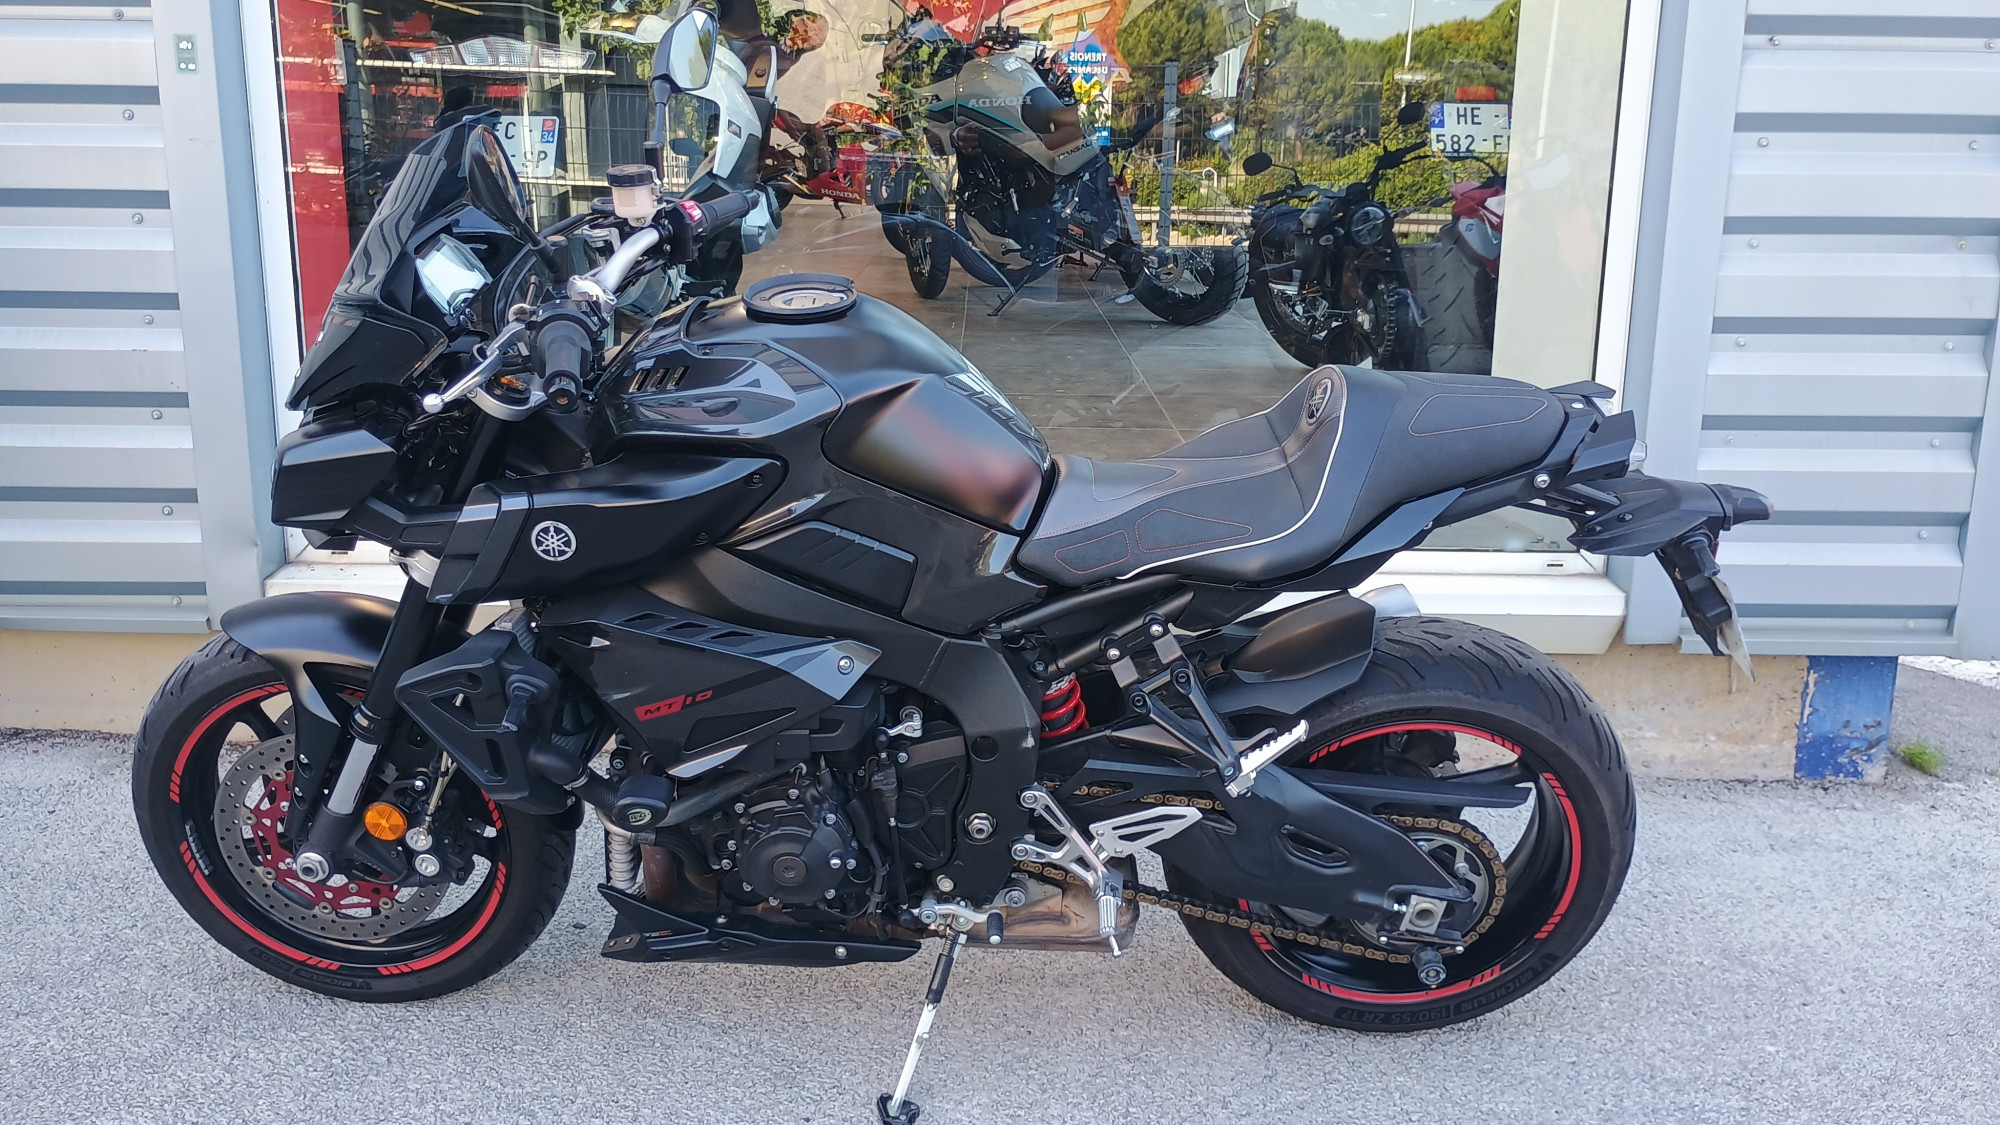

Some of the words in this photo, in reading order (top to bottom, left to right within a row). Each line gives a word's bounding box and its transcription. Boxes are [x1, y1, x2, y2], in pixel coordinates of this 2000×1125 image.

[541, 131, 554, 142] 34
[1435, 133, 1510, 153] 582-F
[821, 188, 861, 200] HONDA
[1460, 969, 1534, 1012] MICHELIN
[1364, 1011, 1386, 1025] ZR
[1389, 1006, 1449, 1025] 190/55
